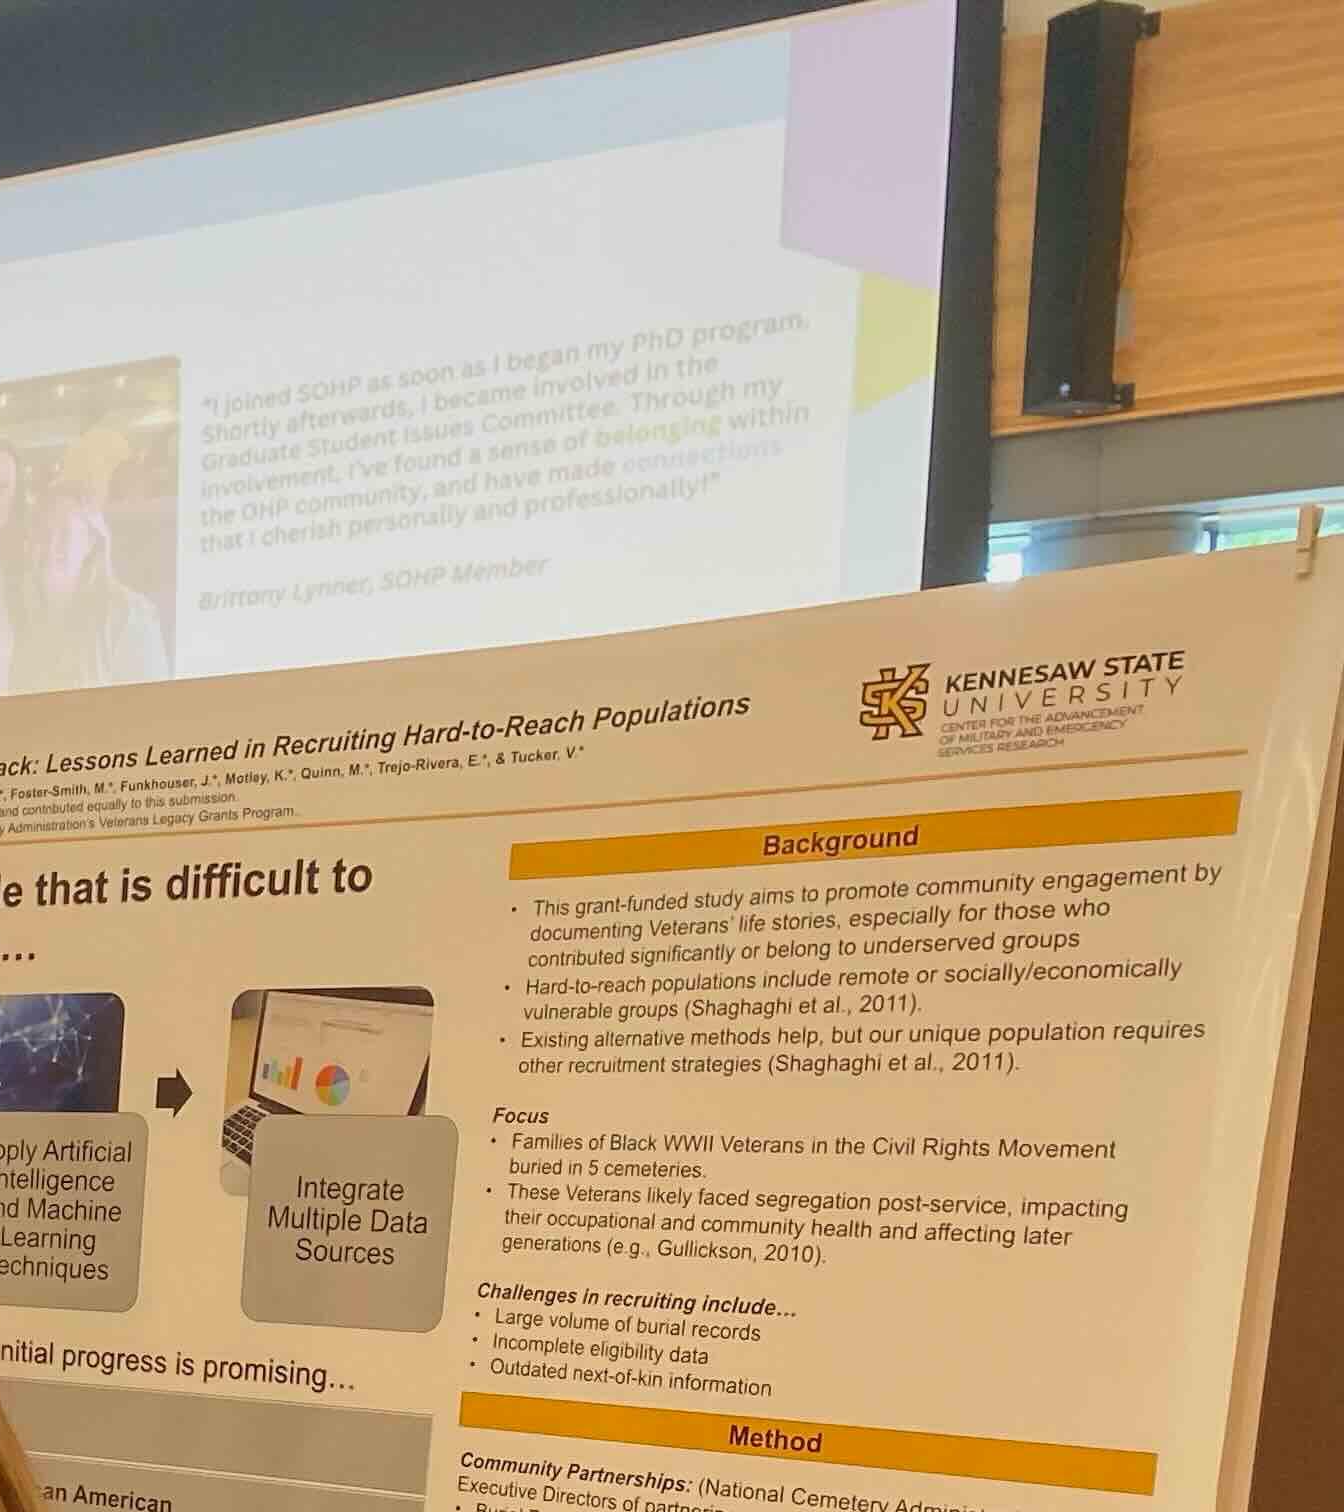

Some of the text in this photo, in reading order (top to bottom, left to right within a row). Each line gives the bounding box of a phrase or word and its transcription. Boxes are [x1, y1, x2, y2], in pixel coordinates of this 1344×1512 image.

[946, 651, 1184, 693] KENNESAW STATE
[944, 676, 1182, 717] UNIVERSITY
[46, 753, 137, 773] Lessons
[146, 740, 238, 766] Learned
[245, 739, 265, 758] in
[273, 729, 396, 756] Recruiting
[403, 710, 584, 746] Hard-to-Reach
[592, 696, 750, 732] Populations
[764, 826, 918, 857] Background
[36, 872, 108, 906] that
[121, 868, 151, 902] is
[167, 859, 319, 900] difficult
[333, 859, 372, 893] to
[534, 863, 1221, 919] This grant-funded study aims to promote community engagement by
[531, 898, 1110, 942] documenting Veterans' life stories, especially for those who
[529, 932, 1079, 967] contributed significantly or belong to underserved groups
[522, 1023, 1205, 1051] Existing alternative methods help, but our unique population requires
[493, 1107, 549, 1124] Focus
[43, 1140, 131, 1164] Artificial
[513, 1133, 1115, 1160] Families of Black WWII Veterans in the Civil Rights Movement
[298, 1176, 404, 1202] Integrate
[28, 1198, 121, 1222] Machine
[268, 1206, 427, 1236] Multiple Data
[0, 1227, 96, 1256] Learning
[296, 1238, 394, 1264] Sources
[478, 1283, 577, 1306] Challenges
[583, 1288, 599, 1304] in
[604, 1292, 696, 1315] recruiting
[496, 1308, 760, 1341] Large volume of burial records
[63, 1349, 166, 1375] progress
[176, 1352, 194, 1375] is
[494, 1333, 708, 1365] Incomplete eligibility data
[491, 1358, 771, 1396] Outdated next-of-kin information
[729, 1425, 822, 1453] Method
[461, 1452, 563, 1481] Community
[567, 1464, 693, 1494] Partnerships:
[699, 1478, 784, 1502] (National
